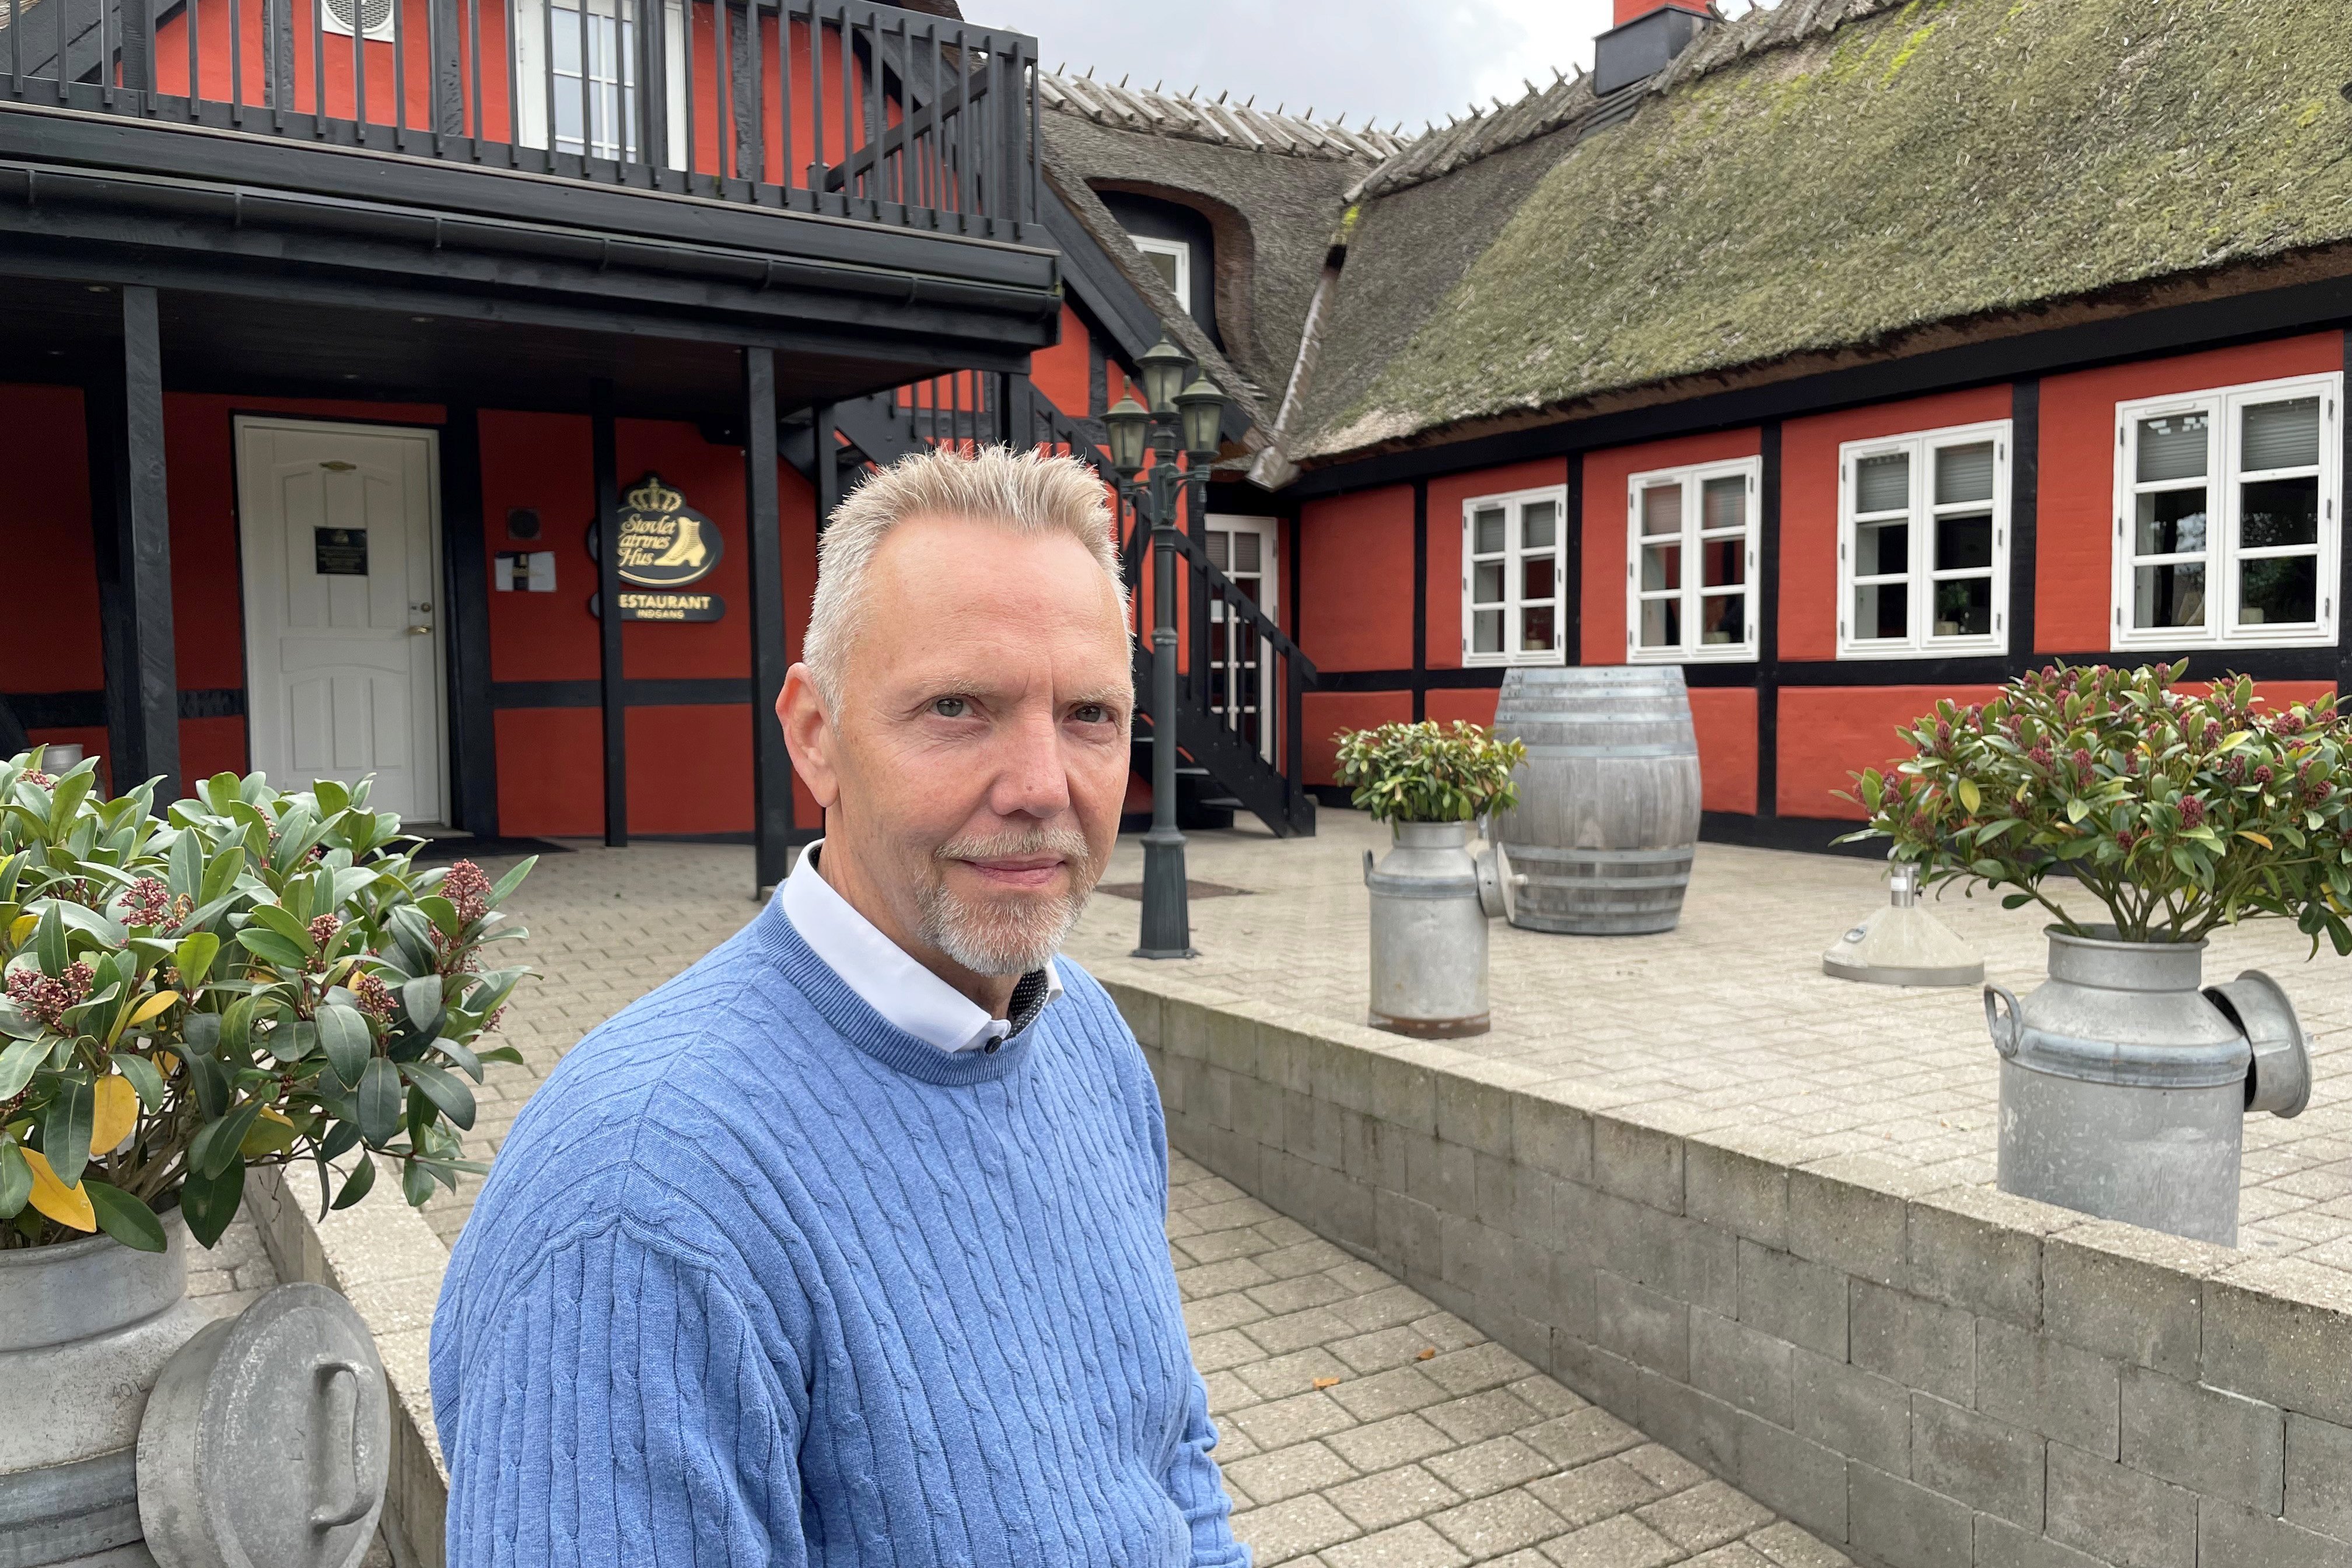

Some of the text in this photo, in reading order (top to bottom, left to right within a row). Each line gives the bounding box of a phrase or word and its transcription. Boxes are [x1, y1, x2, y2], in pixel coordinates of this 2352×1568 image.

[618, 533, 671, 549] atrines
[617, 547, 654, 567] Hus
[618, 594, 711, 610] ESTAURANT
